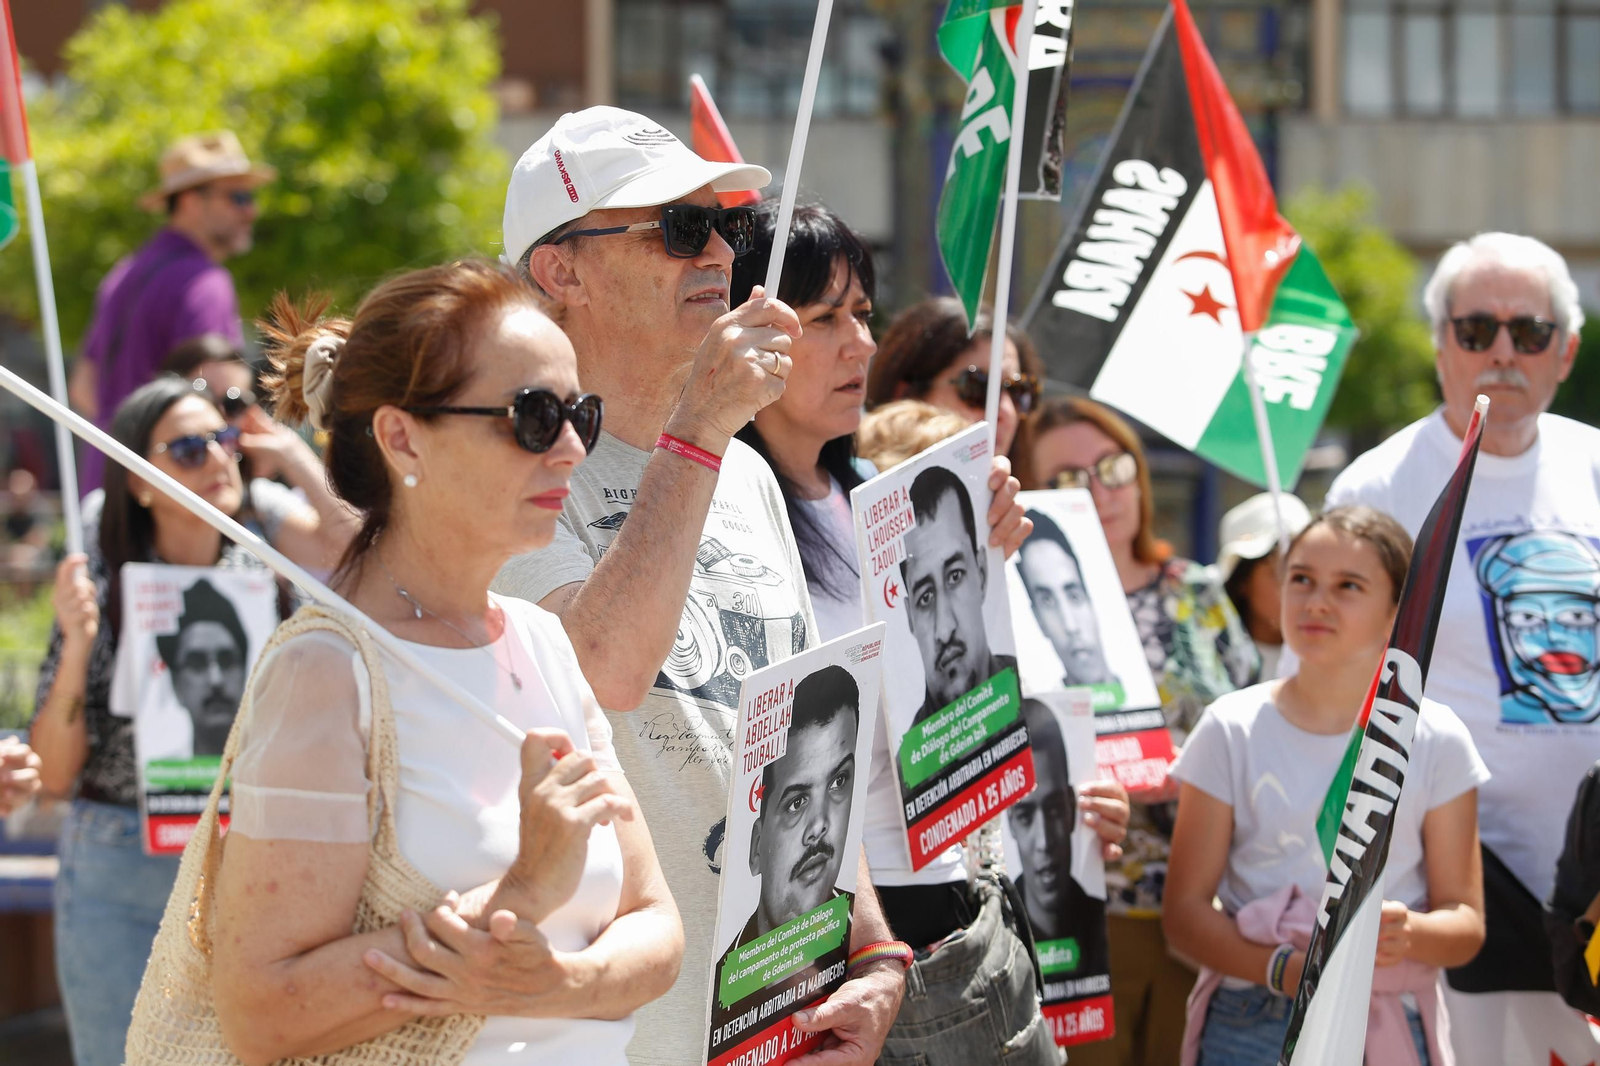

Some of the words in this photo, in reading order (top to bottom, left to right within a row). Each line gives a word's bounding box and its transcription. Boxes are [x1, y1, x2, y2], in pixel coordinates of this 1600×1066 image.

[864, 490, 901, 529] LIBERAR
[902, 485, 909, 502] A
[868, 506, 914, 552] LHOUSSEIN
[871, 547, 898, 576] ZAOUI
[747, 683, 785, 722] LIBERAR
[787, 678, 794, 700] A
[921, 709, 954, 739] Miembro
[954, 701, 967, 717] del
[967, 682, 994, 709] Comité
[744, 703, 792, 750] ABDELLAH
[910, 748, 921, 764] de
[921, 730, 950, 759] Diálogo
[950, 721, 962, 740] del
[961, 693, 1010, 734] Campamento
[939, 748, 950, 764] de
[949, 735, 974, 761] Gdeim
[972, 724, 988, 746] Izik
[743, 735, 780, 775] TOUBALI
[906, 801, 916, 821] EN
[916, 781, 949, 816] DETENCIÓN
[948, 760, 983, 792] ARBITRARIA
[982, 753, 993, 771] EN
[992, 726, 1029, 766] MARRUECOS
[919, 798, 976, 855] CONDENADO
[978, 793, 986, 816] A
[986, 781, 1000, 811] 25
[1000, 765, 1026, 802] AÑOS
[727, 971, 739, 985] del
[739, 951, 780, 979] campamento
[780, 944, 789, 958] de
[788, 931, 816, 957] protesta
[816, 919, 841, 943] pacífica
[738, 941, 767, 964] Miembro
[767, 934, 778, 949] del
[777, 922, 801, 944] Comité
[800, 916, 809, 930] de
[809, 906, 834, 926] Diálogo
[762, 968, 772, 982] de
[771, 959, 793, 977] Gdeim
[792, 951, 805, 969] Izik
[712, 1029, 723, 1048] EN
[722, 1005, 759, 1043] DETENCIÓN
[758, 990, 797, 1023] ARBITRARIA
[797, 981, 808, 999] EN
[807, 959, 846, 995] MARRUECOS
[780, 1030, 788, 1055] A
